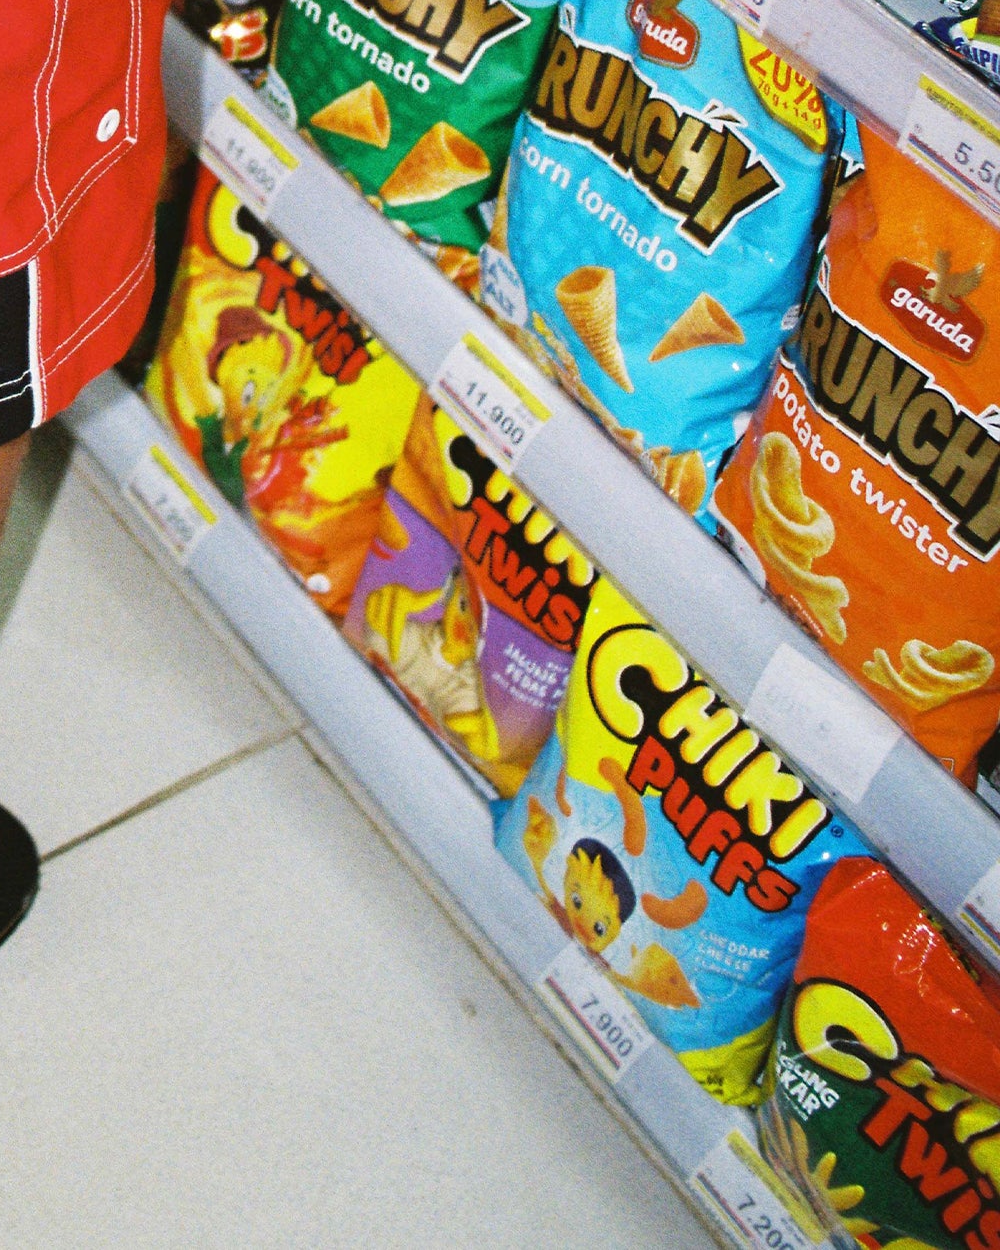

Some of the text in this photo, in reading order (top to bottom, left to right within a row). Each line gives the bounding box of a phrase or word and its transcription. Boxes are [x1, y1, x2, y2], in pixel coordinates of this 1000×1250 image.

[325, 11, 431, 94] tornado
[576, 176, 679, 273] tornado
[890, 285, 976, 354] garuda
[465, 381, 526, 446] 11.900
[773, 372, 842, 474] potato
[850, 467, 969, 573] twister
[466, 496, 583, 648] Twis
[590, 627, 828, 860] CHIKI
[580, 992, 634, 1058] 7.900
